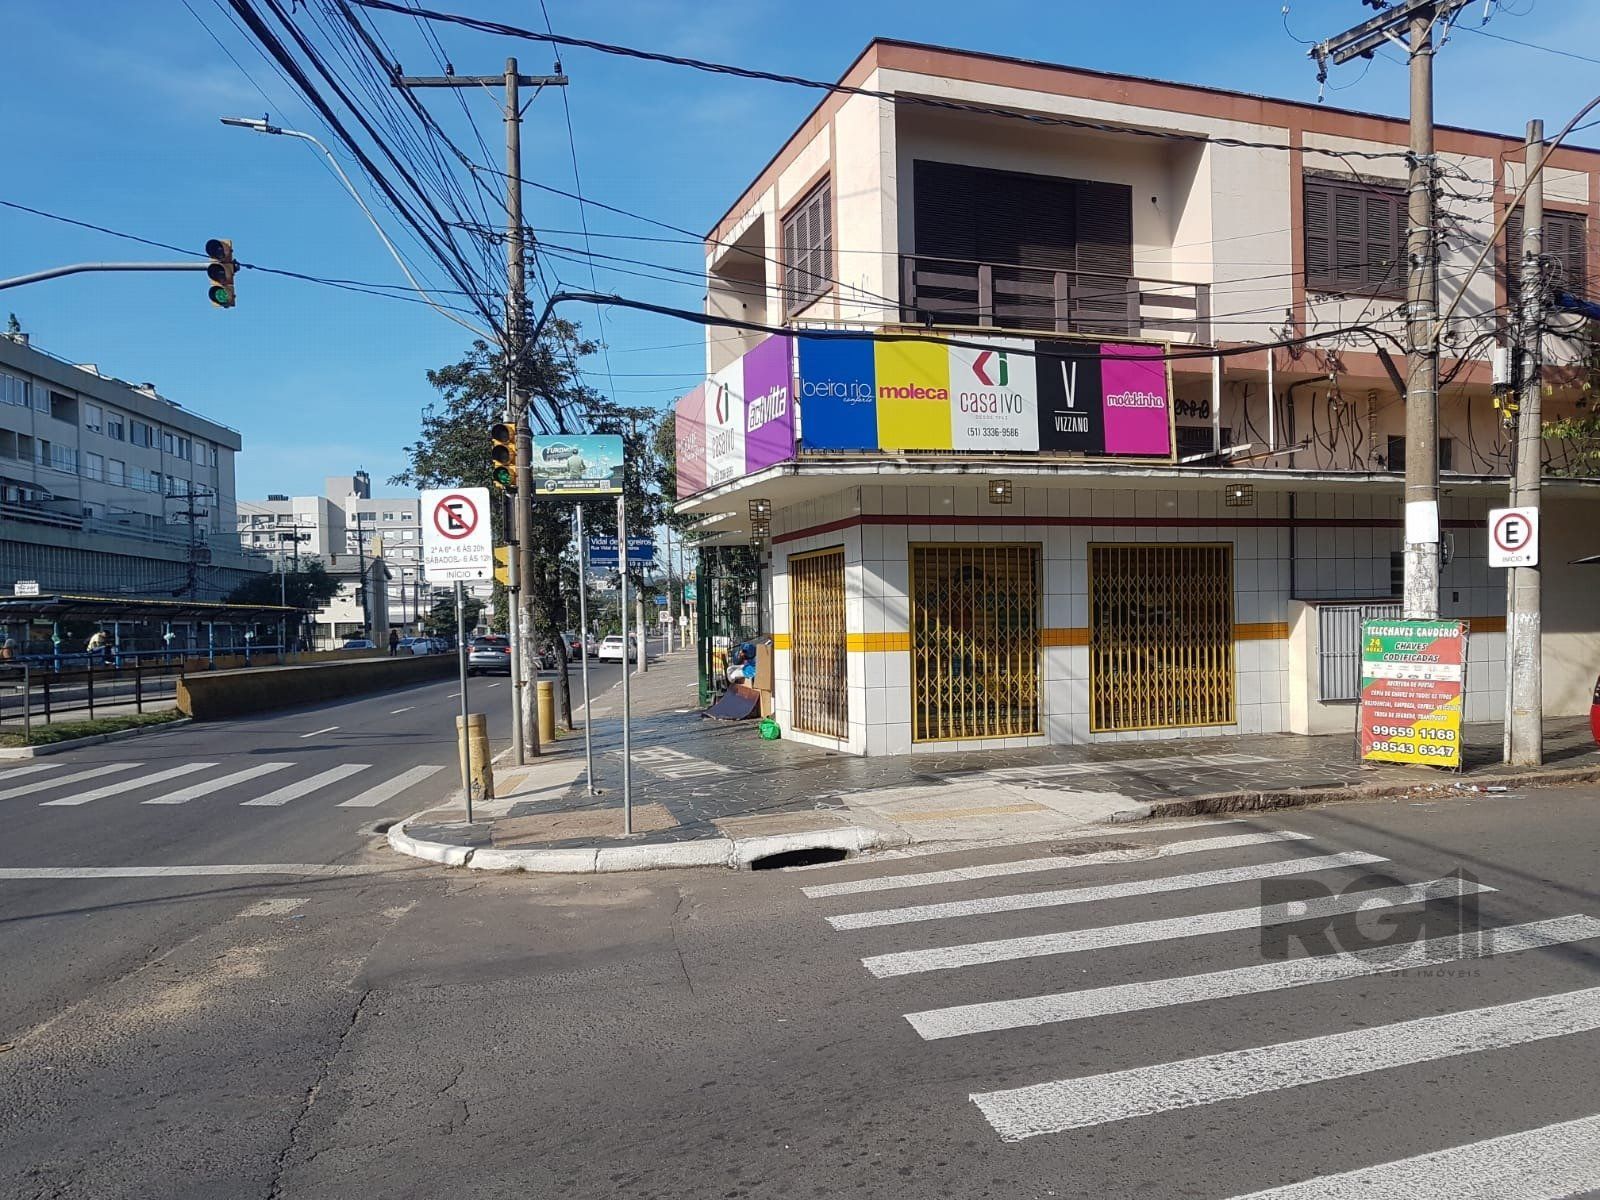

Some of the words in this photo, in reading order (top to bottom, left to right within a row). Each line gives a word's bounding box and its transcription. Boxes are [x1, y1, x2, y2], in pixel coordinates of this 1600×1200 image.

[802, 378, 847, 397] beira
[850, 379, 872, 397] rio
[879, 383, 948, 400] moleca
[1061, 360, 1077, 408] V
[1107, 391, 1165, 408] molekinha
[1055, 416, 1089, 433] VIZZANO
[448, 504, 464, 530] E
[1506, 521, 1519, 544] E
[446, 570, 471, 579] INÍCIO
[1395, 641, 1428, 651] CHAVES
[1382, 652, 1440, 663] CODIFICADAS
[1372, 725, 1415, 737] 99659
[1418, 728, 1455, 740] 1168
[1372, 741, 1415, 754] 98543
[1418, 744, 1454, 757] 6347
